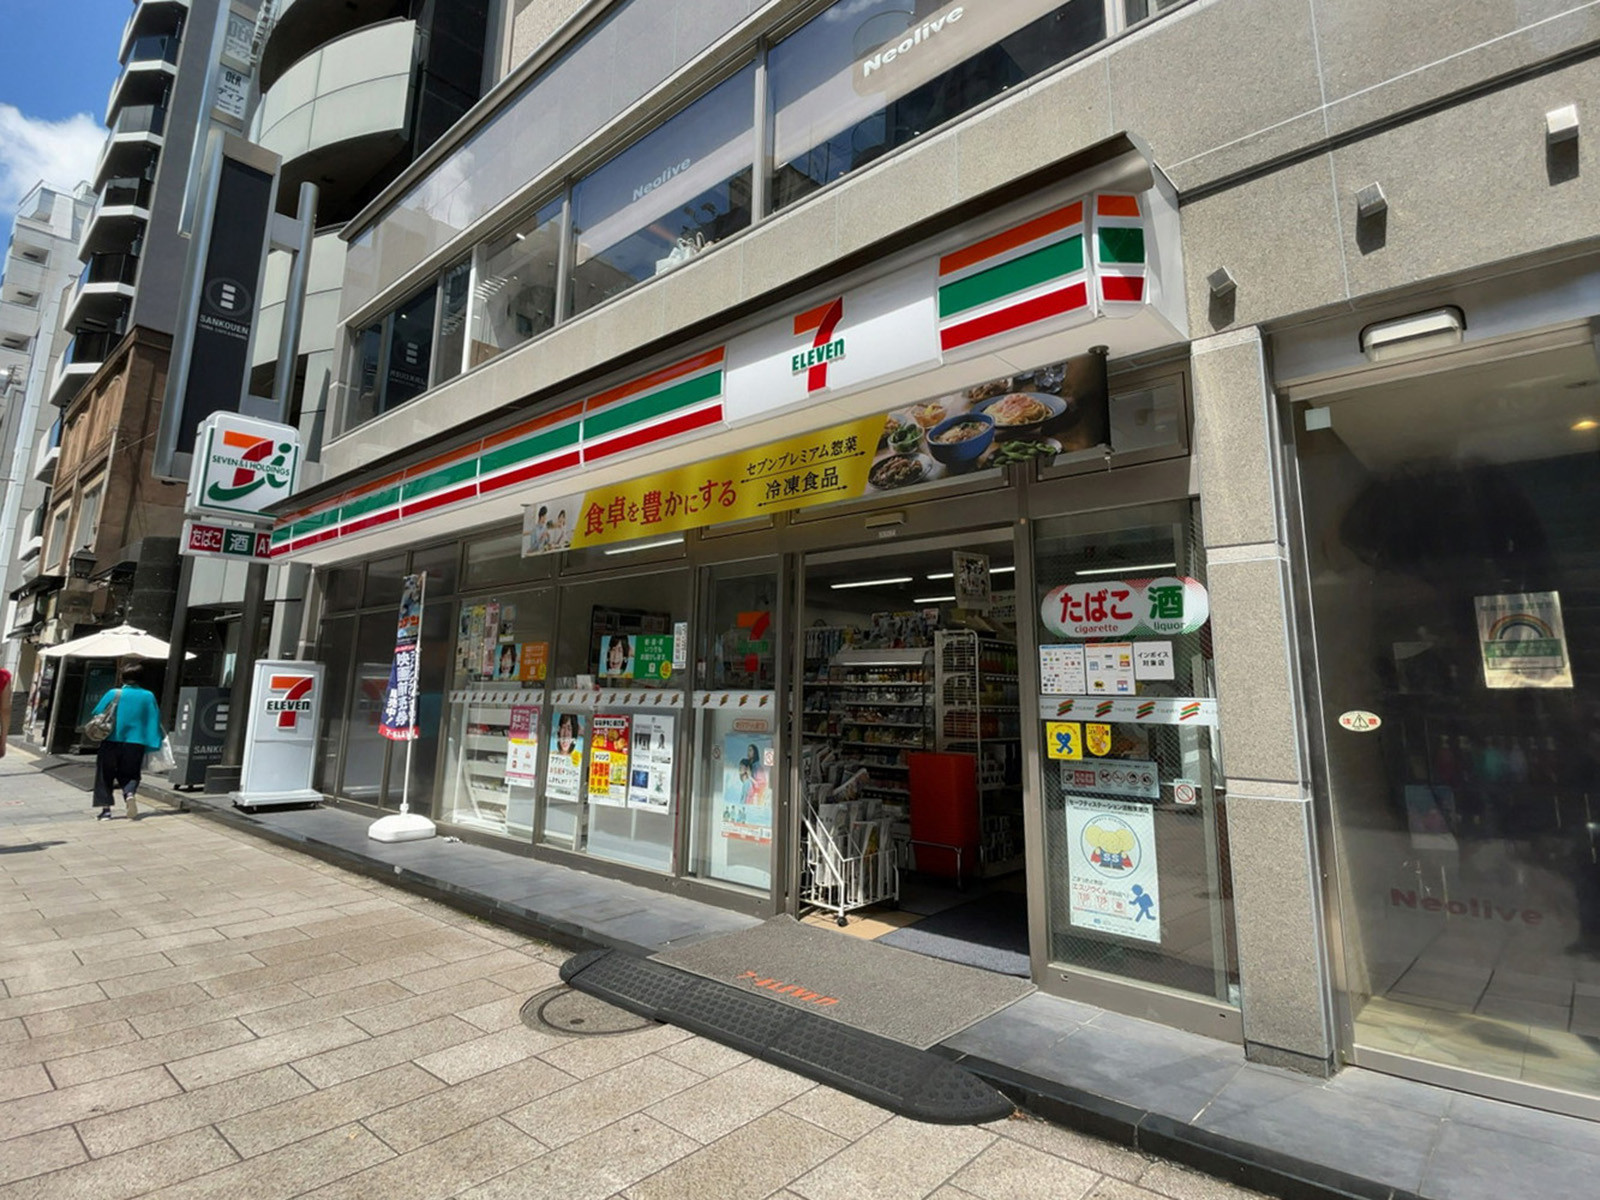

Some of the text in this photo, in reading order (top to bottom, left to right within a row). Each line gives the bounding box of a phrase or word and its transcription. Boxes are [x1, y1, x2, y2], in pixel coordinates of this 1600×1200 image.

[863, 5, 965, 77] Neolive
[632, 156, 691, 201] Neolive
[199, 314, 249, 334] SANKOUEN
[249, 462, 290, 476] HOLDINGS
[745, 435, 858, 477] セブンプレミアム惣菜
[765, 466, 839, 500] 冷凍食品
[584, 478, 737, 537] 食卓を豊かにする
[190, 529, 221, 548] たばこ
[229, 533, 250, 551] 酒
[1060, 585, 1184, 623] たばこ 酒
[1074, 621, 1185, 634] cigarette liquor
[1137, 651, 1169, 659] インボイス
[1391, 888, 1543, 926] Neolive
